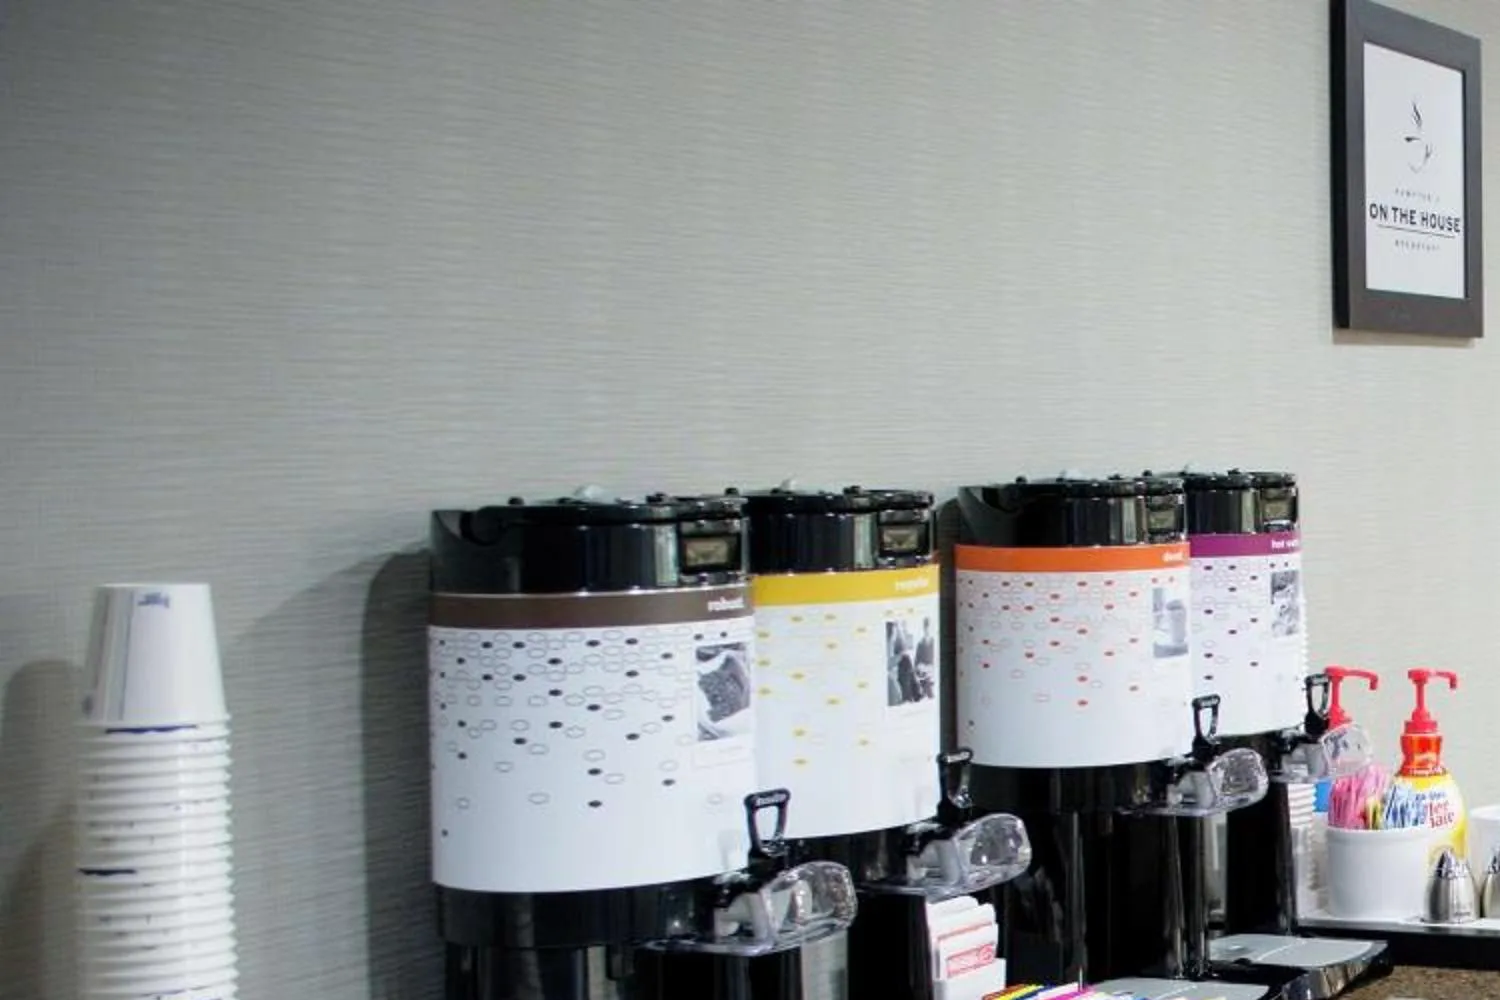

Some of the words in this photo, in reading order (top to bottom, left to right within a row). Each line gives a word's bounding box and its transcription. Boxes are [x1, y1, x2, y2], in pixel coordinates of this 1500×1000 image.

[1369, 203, 1388, 221] ON
[1391, 206, 1417, 225] THE
[1420, 211, 1461, 233] HOUSE
